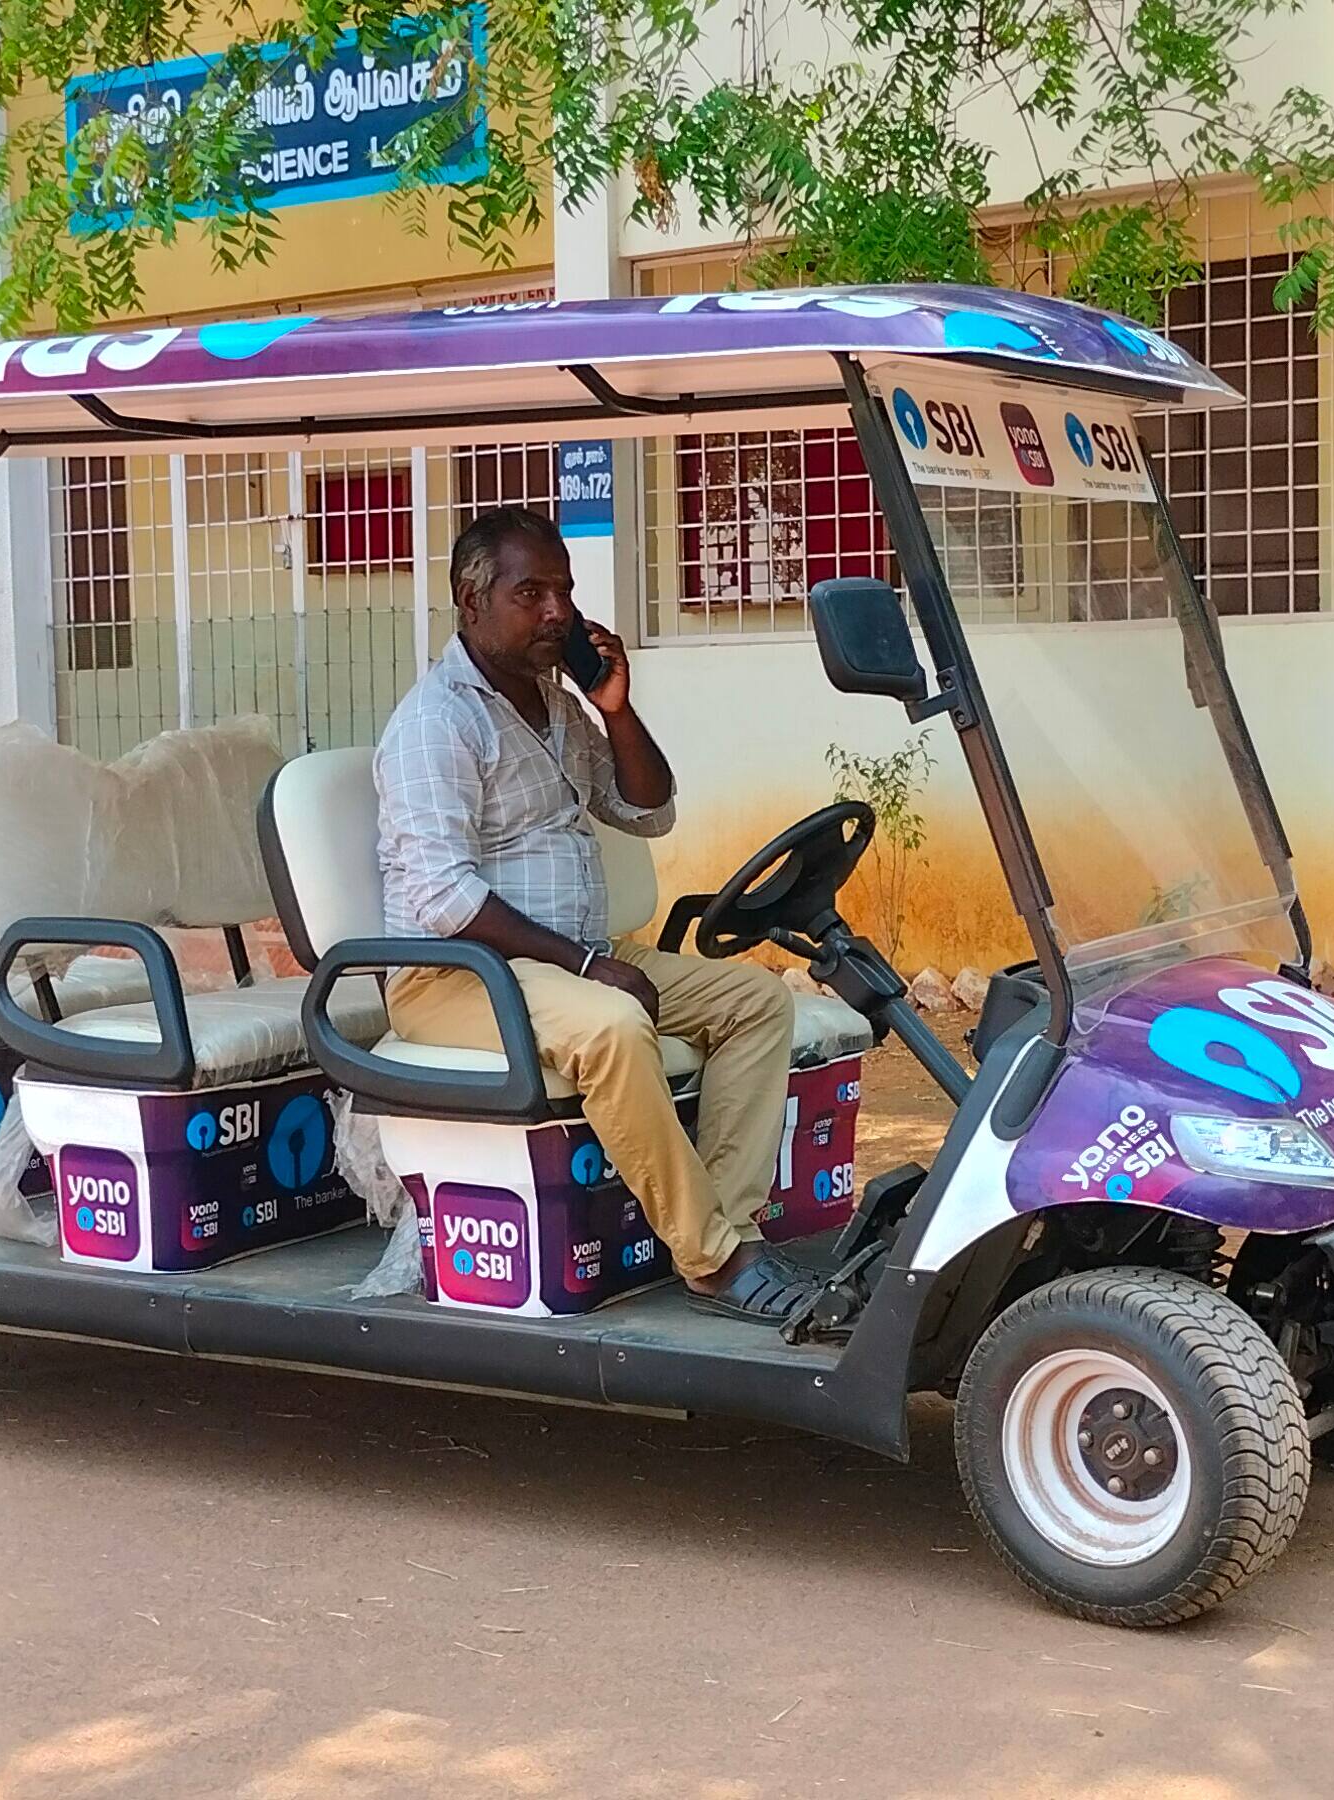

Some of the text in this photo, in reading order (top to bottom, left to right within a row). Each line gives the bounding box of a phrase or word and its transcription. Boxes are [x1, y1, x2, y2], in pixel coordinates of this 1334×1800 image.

[924, 399, 985, 458] SBI
[1008, 426, 1040, 448] yono
[1028, 449, 1046, 468] SBI
[1091, 422, 1142, 474] SBI
[559, 474, 581, 501] 169
[588, 472, 612, 500] 172
[219, 1100, 261, 1146] SBI
[1295, 1108, 1329, 1129] The
[1062, 1105, 1146, 1190] yono
[1091, 1119, 1158, 1182] BUSINESS
[1123, 1133, 1176, 1179] SBI
[67, 1174, 130, 1206] yono
[294, 1186, 348, 1210] The banker
[94, 1208, 126, 1237] SBI
[189, 1201, 219, 1220] yono
[255, 1199, 278, 1224] SBI
[203, 1221, 218, 1237] SBI
[443, 1214, 518, 1248] yono
[572, 1240, 602, 1260] yono
[634, 1237, 654, 1264] SBI
[475, 1252, 512, 1282] SBI
[586, 1262, 601, 1279] SBI
